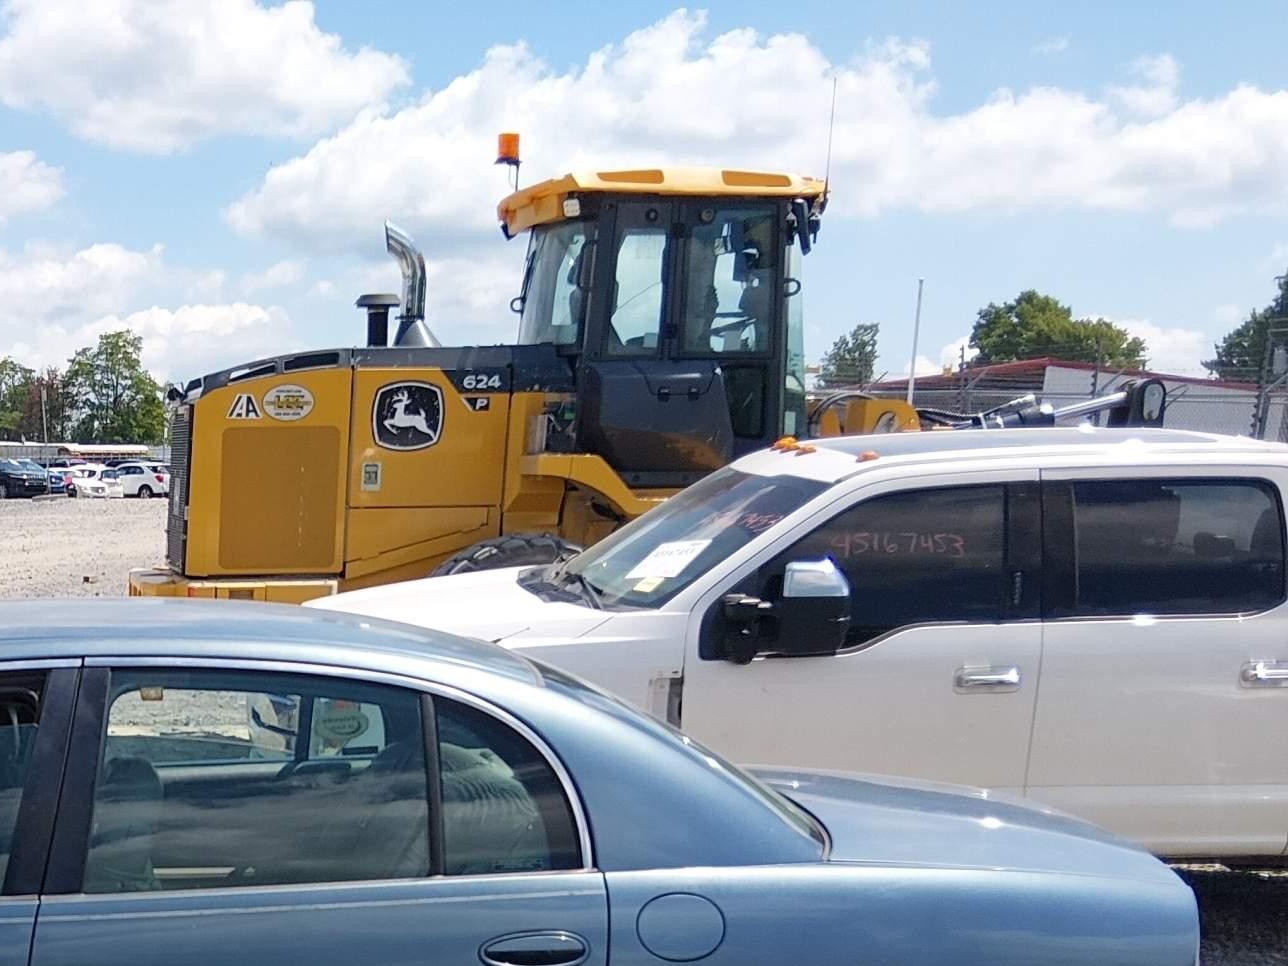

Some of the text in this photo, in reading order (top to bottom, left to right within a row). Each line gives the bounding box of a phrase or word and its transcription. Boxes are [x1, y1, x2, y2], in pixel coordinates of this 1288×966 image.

[463, 374, 501, 389] 624
[475, 398, 489, 410] P
[830, 532, 965, 558] 45167453
